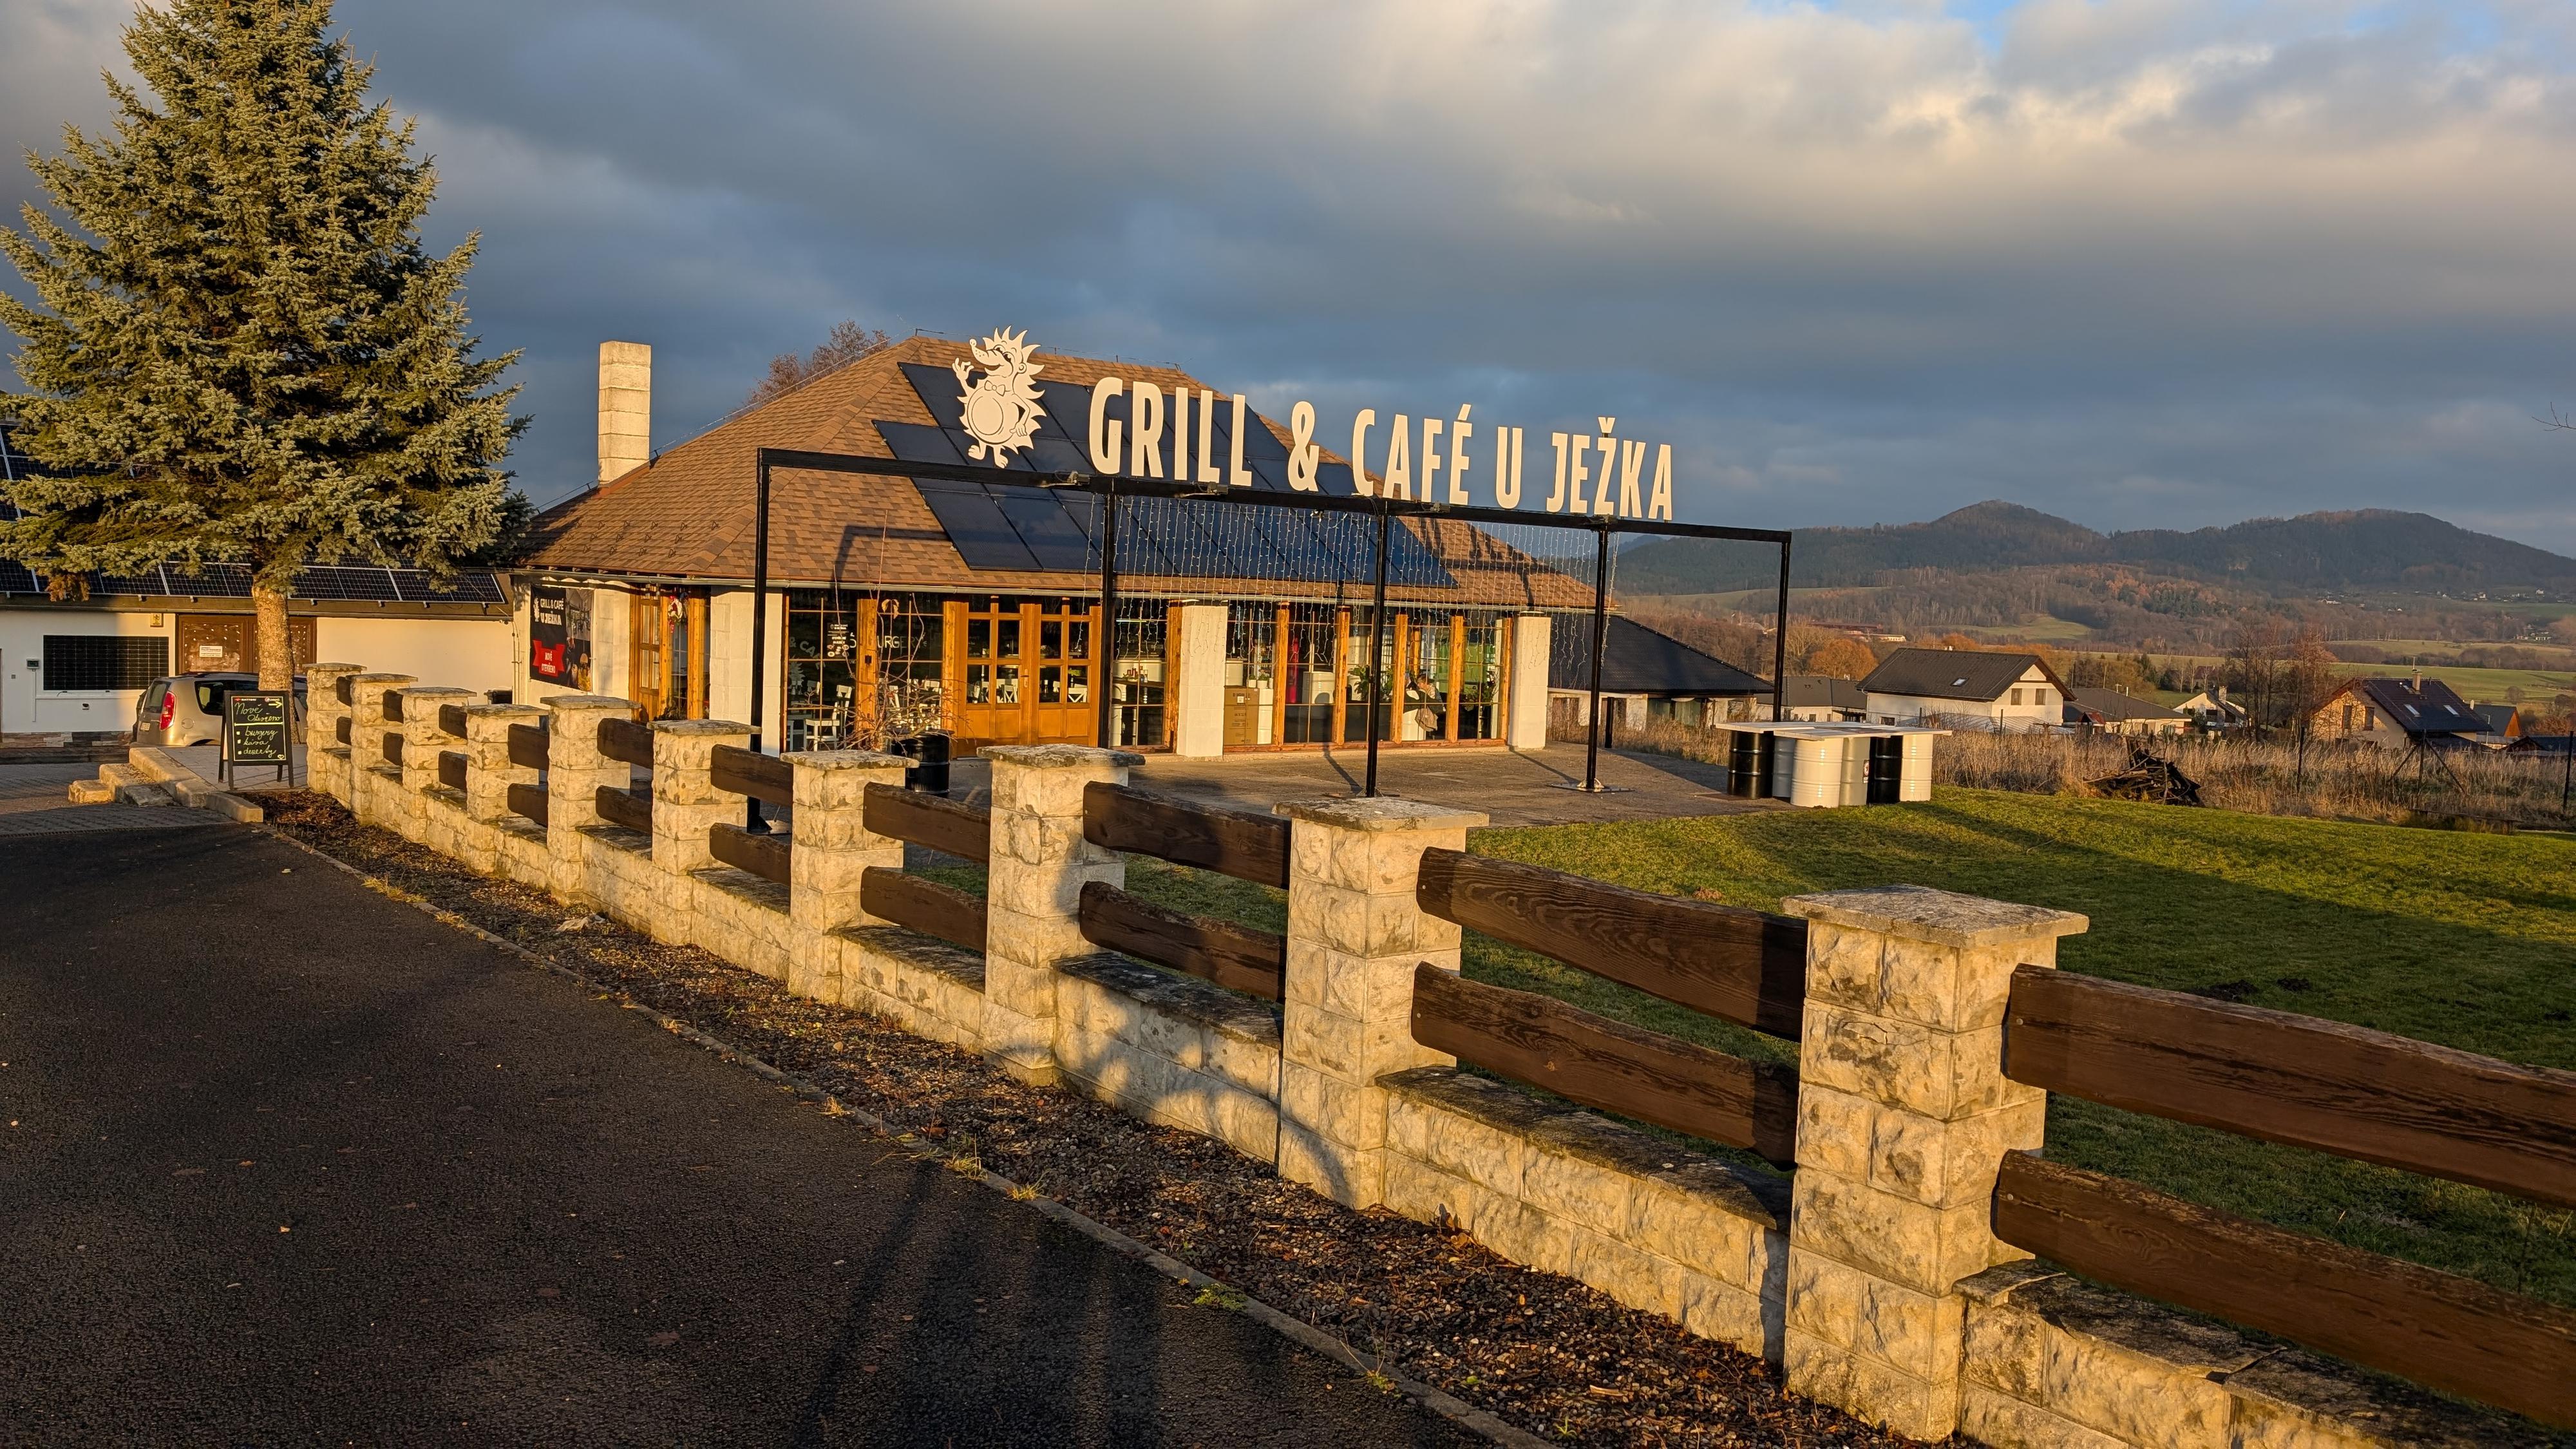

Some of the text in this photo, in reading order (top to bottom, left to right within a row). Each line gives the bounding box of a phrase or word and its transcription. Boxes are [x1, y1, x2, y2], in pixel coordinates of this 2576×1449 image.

[1089, 376, 1672, 521] GRILL & CAFÉ U JEŽKA
[540, 598, 551, 609] GRILL
[554, 598, 564, 610] CAFÉ
[544, 611, 562, 625] JEŽKA
[245, 726, 278, 741] burgery
